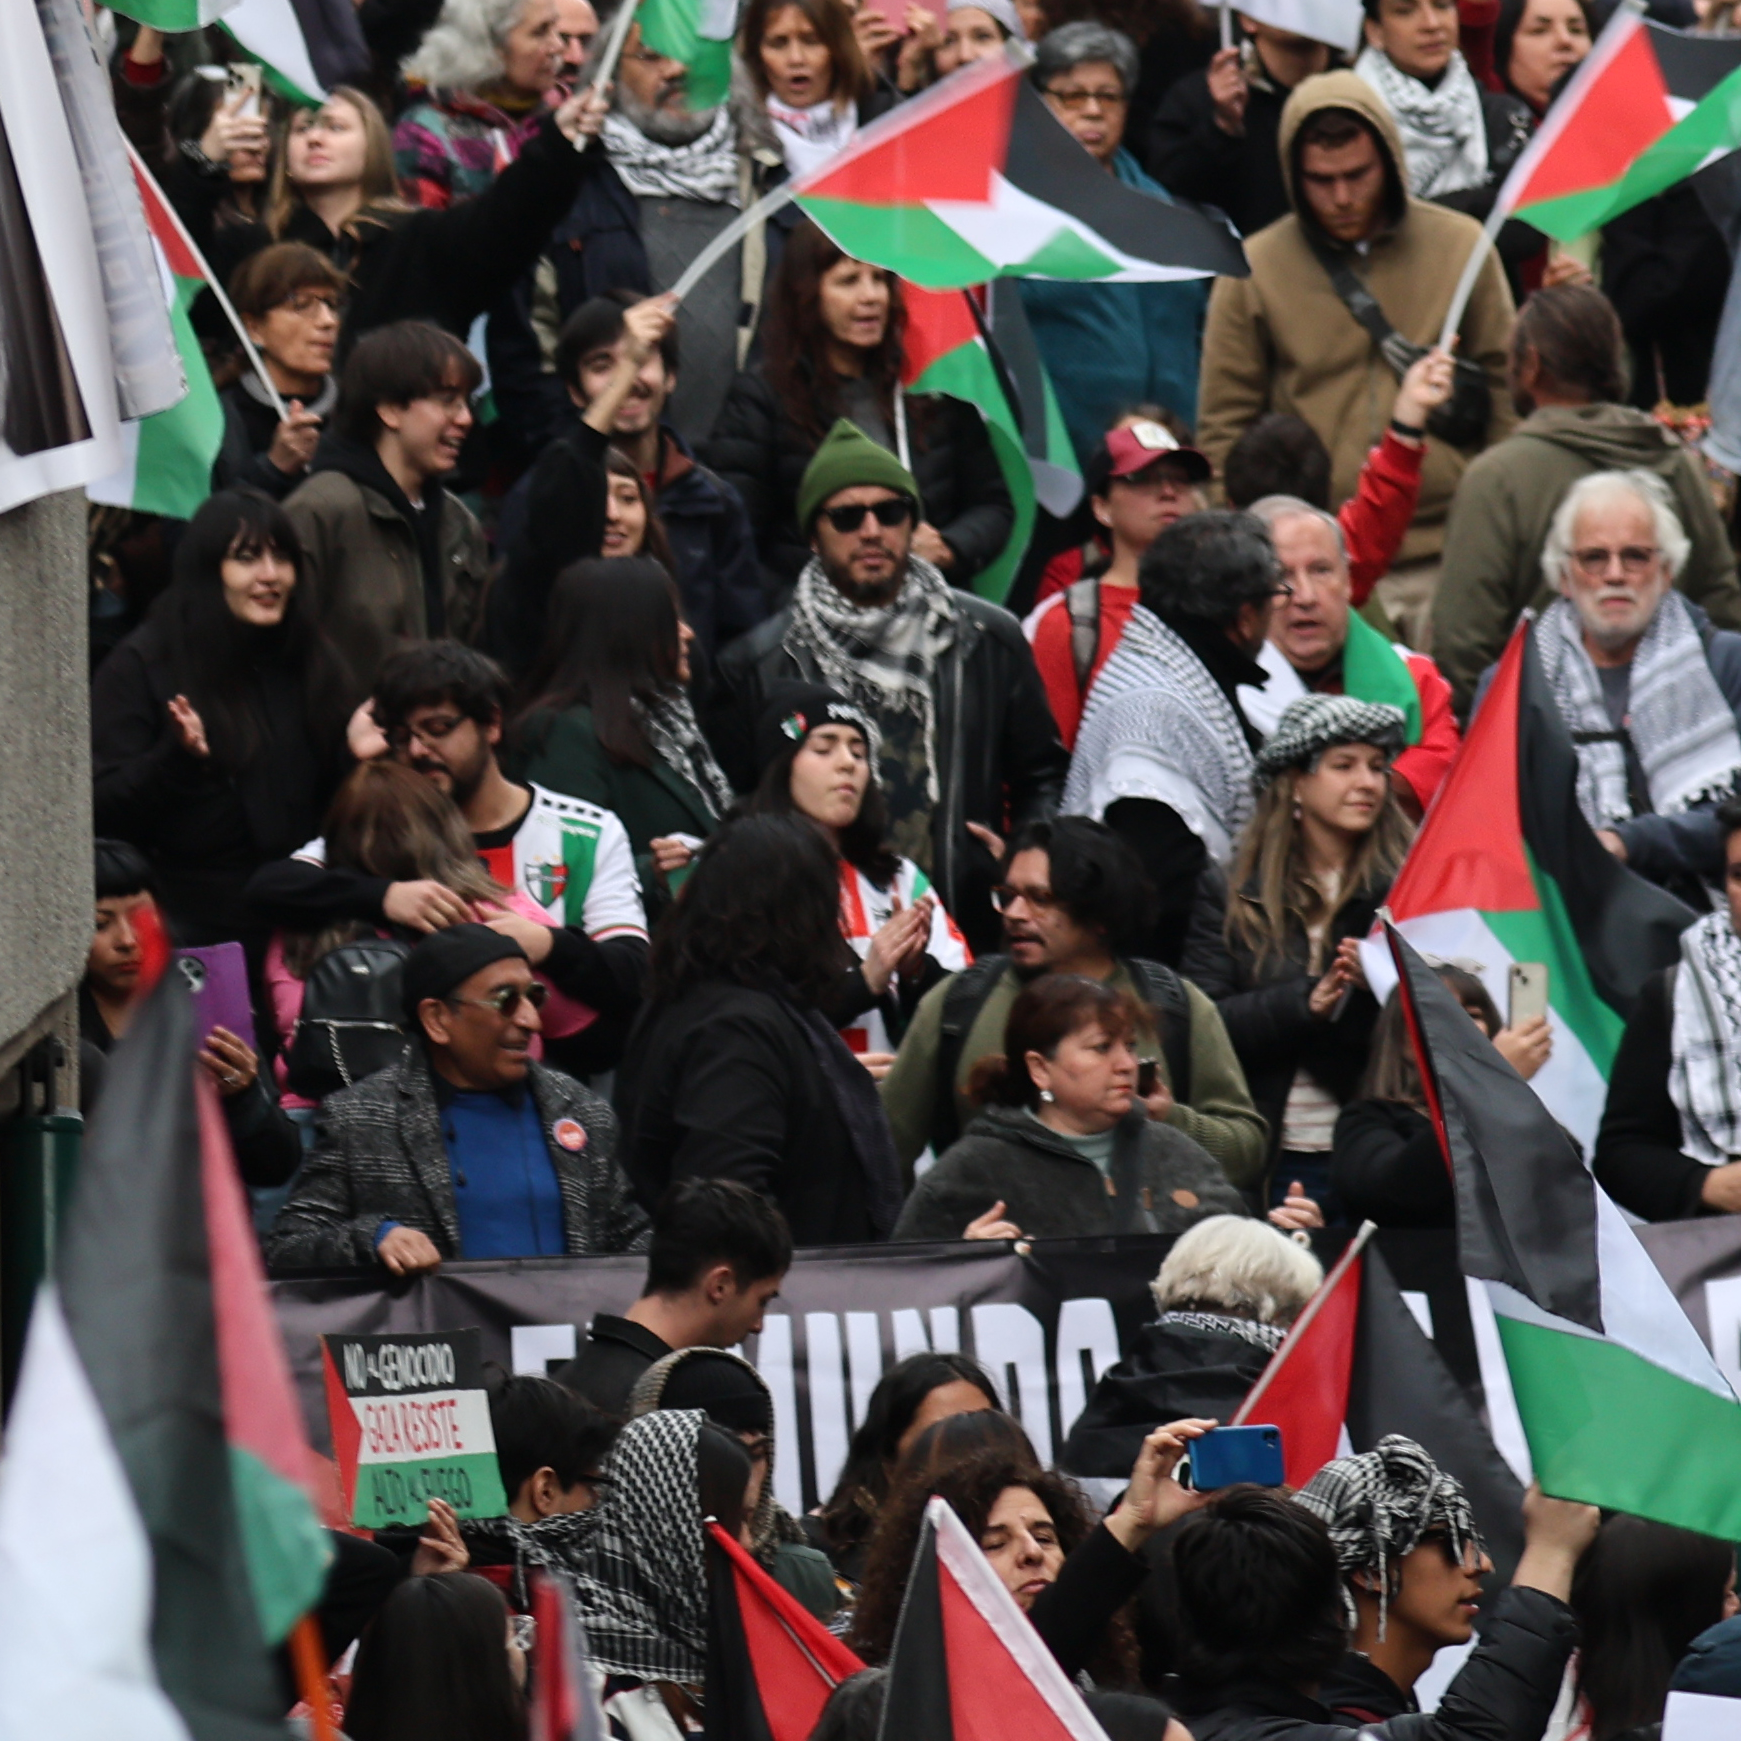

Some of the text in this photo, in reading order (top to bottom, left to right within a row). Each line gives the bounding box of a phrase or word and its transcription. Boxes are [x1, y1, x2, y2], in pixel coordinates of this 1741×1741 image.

[343, 1342, 369, 1390] NO
[378, 1342, 457, 1390] GENOCIDIO
[365, 1398, 465, 1455] GAZA RESISTE
